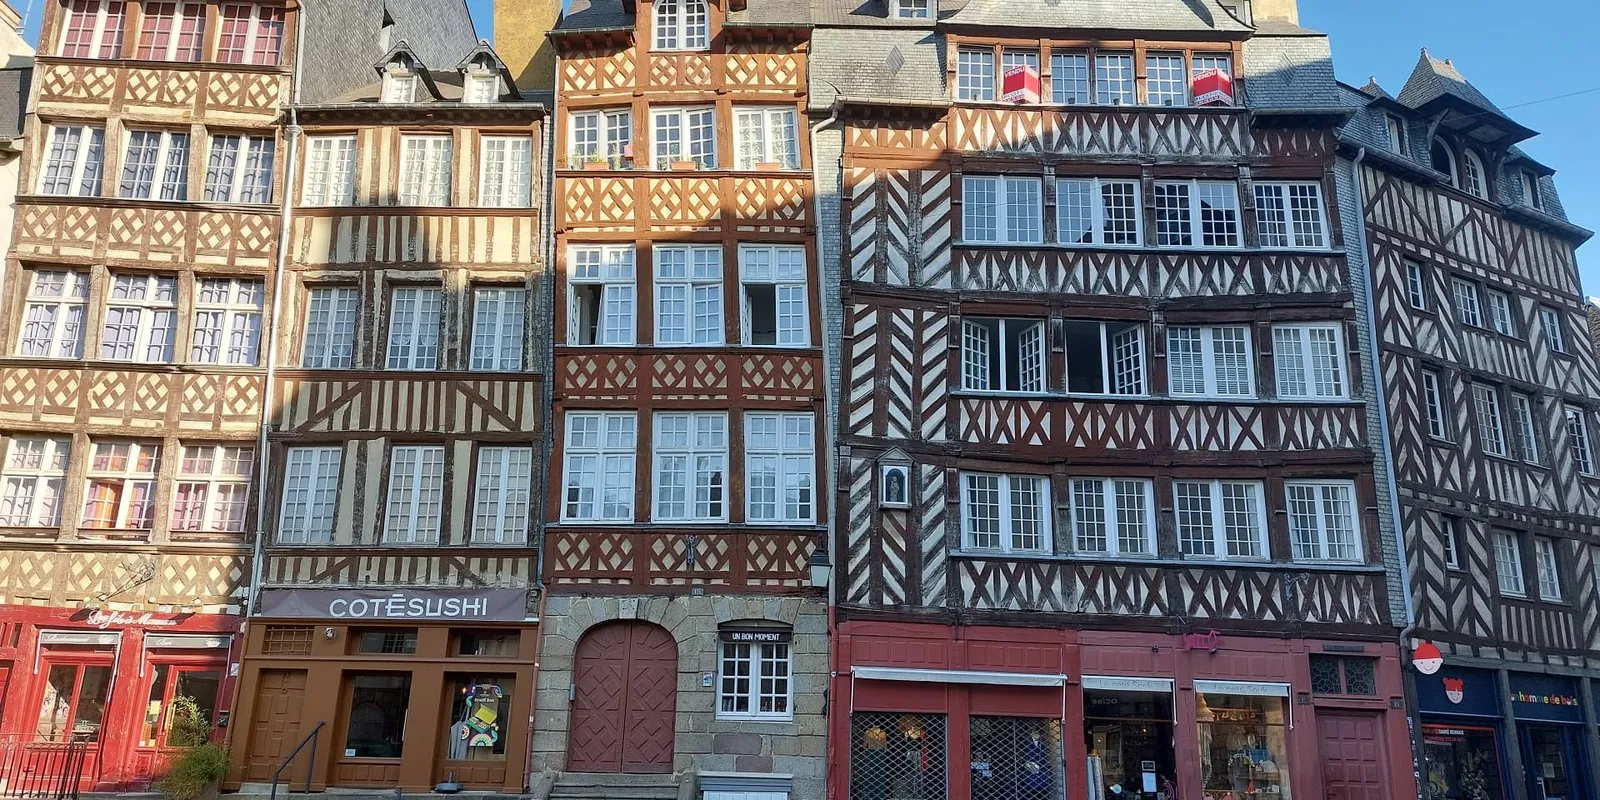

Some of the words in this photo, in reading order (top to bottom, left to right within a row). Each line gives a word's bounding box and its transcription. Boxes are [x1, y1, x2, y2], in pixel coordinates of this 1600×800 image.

[1004, 65, 1025, 78] VENDU
[1192, 70, 1217, 82] VENDU
[732, 632, 741, 640] UN
[741, 633, 753, 641] BON
[754, 633, 780, 641] MOMENT
[1550, 694, 1560, 704] de
